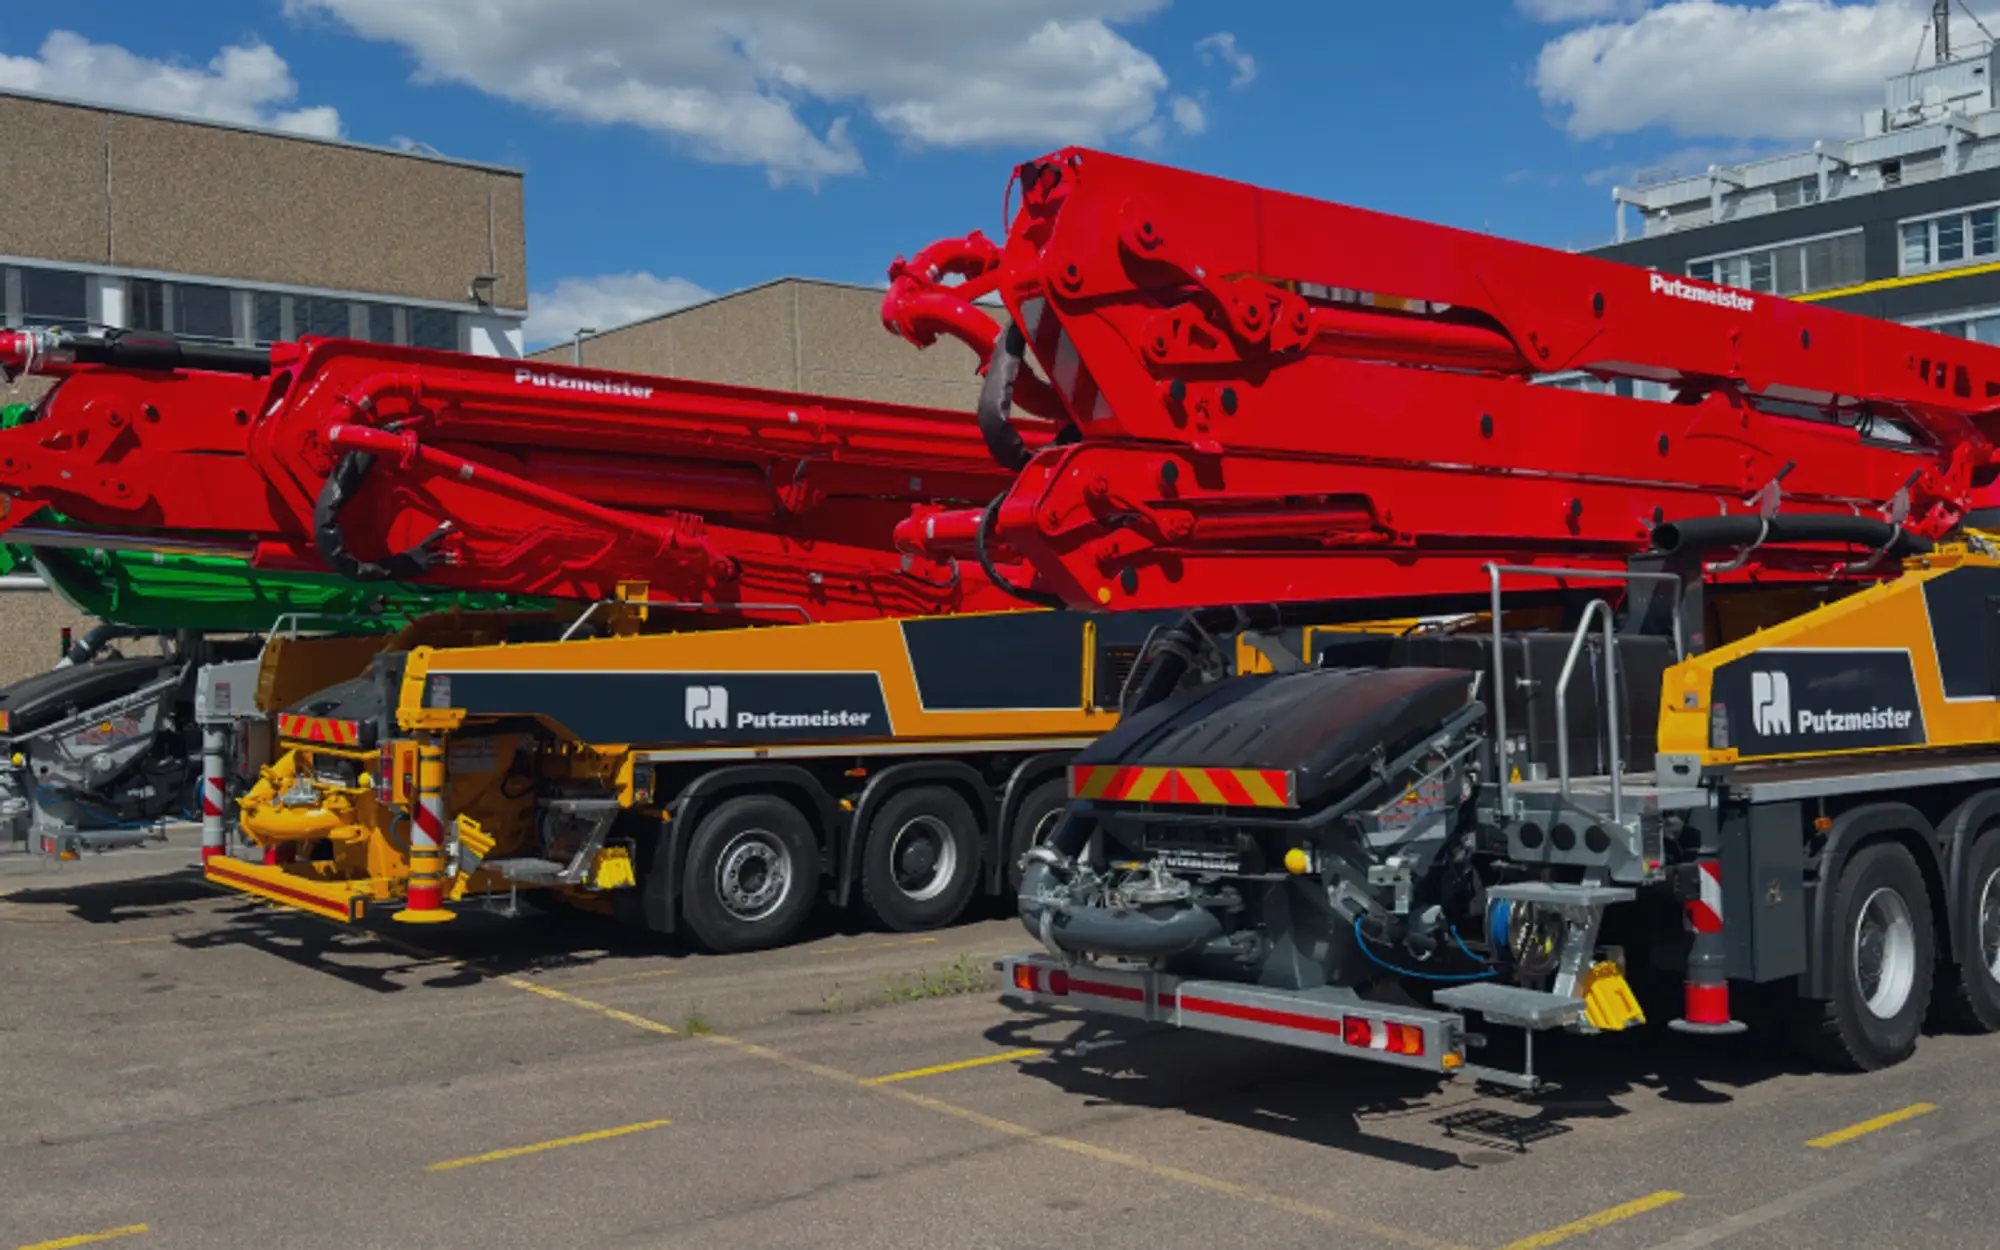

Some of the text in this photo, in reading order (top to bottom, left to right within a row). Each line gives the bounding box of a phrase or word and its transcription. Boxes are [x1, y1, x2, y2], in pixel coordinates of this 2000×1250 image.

[1649, 272, 1754, 312] Putzmeister
[514, 367, 654, 398] Putzmeister
[736, 710, 871, 729] Putzmeister
[1797, 706, 1912, 734] Putzmeister
